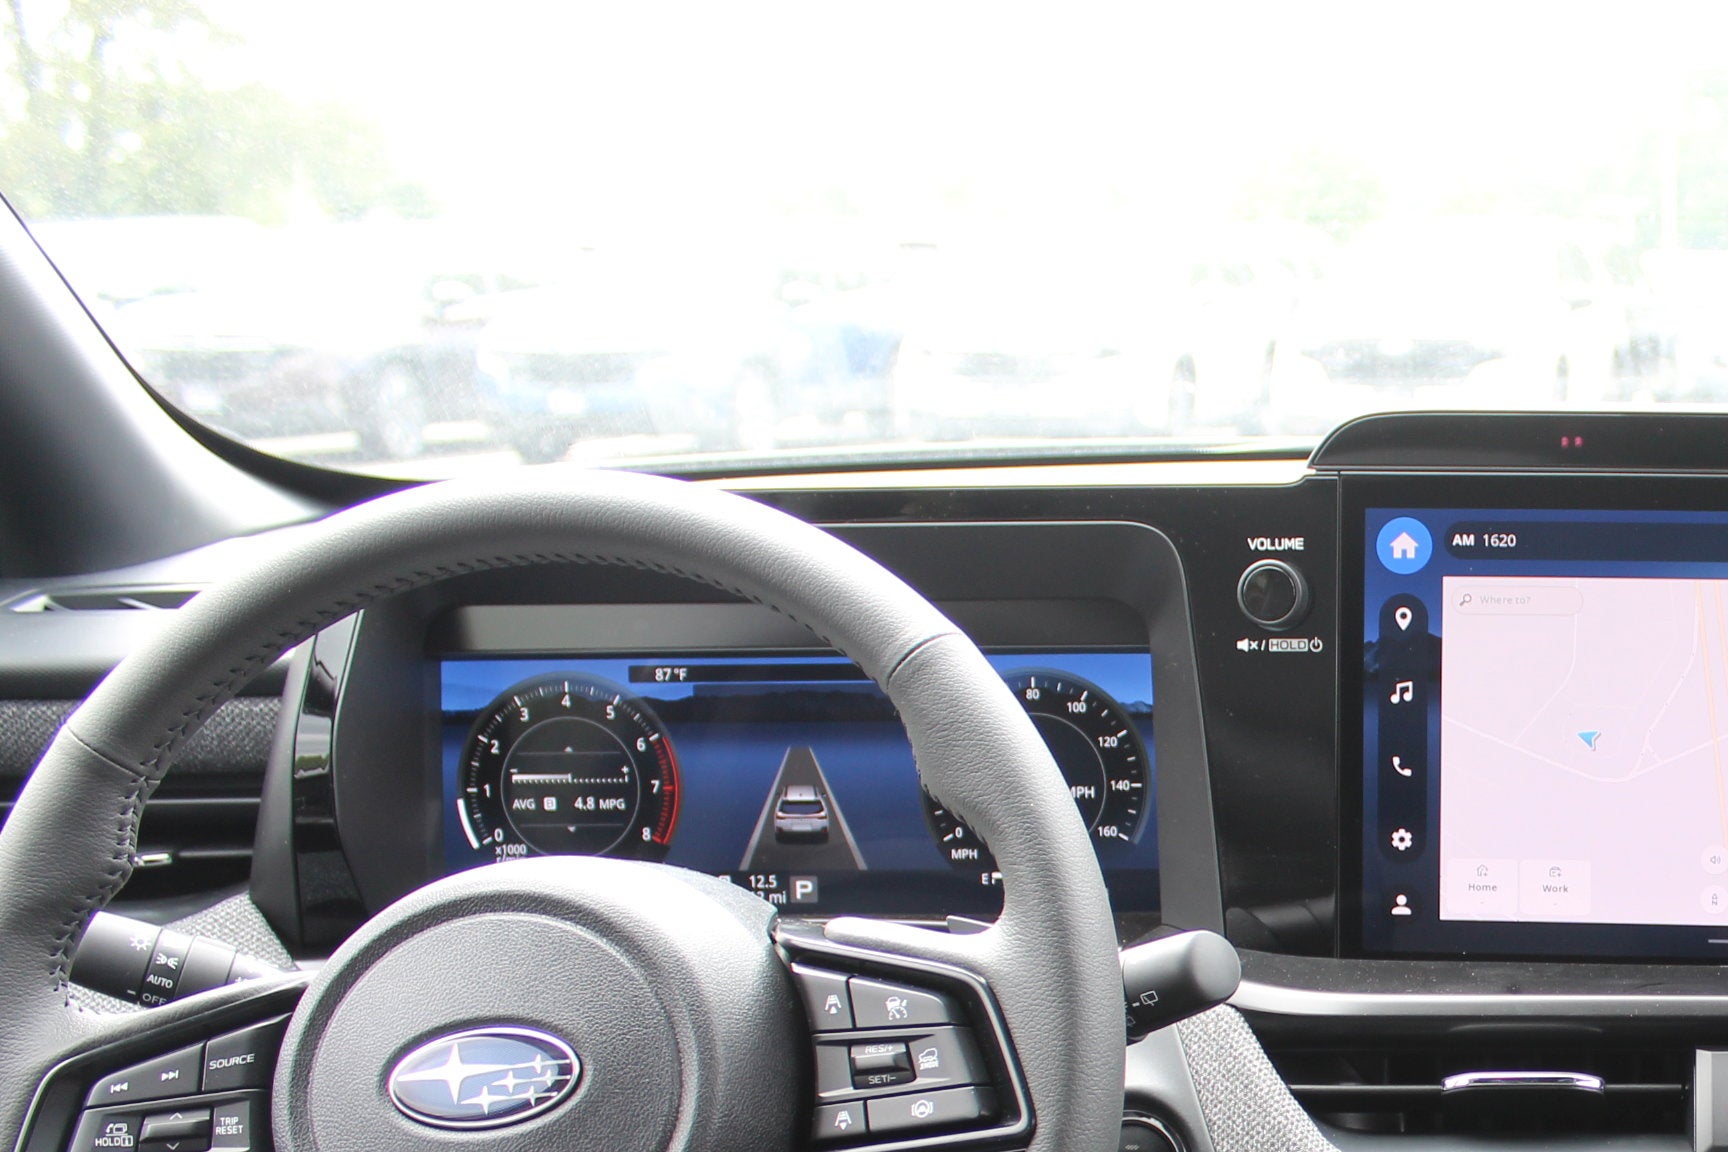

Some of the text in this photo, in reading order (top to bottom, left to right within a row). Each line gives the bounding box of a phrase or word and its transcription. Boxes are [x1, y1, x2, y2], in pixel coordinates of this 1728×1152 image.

[1248, 538, 1304, 550] VOLUME
[1452, 534, 1517, 548] AM 1620
[1480, 595, 1532, 605] Where to?
[1270, 640, 1308, 651] HOLD
[1026, 688, 1040, 700] 80
[561, 695, 571, 708] 4
[1066, 701, 1087, 714] 100
[520, 708, 530, 722] 3
[606, 705, 616, 720] 5
[490, 740, 500, 754] 2
[636, 738, 646, 752] 6
[1098, 736, 1118, 748] 120
[484, 784, 491, 798] 1
[651, 780, 660, 794] 7
[1110, 779, 1130, 792] 140
[512, 799, 536, 810] AVG
[574, 797, 595, 810] 4.8
[600, 799, 626, 810] MPG
[494, 829, 504, 842] 0
[642, 827, 651, 841] 8
[955, 827, 962, 838] 0
[1097, 826, 1118, 838] 160
[495, 844, 527, 855] x1000
[951, 849, 978, 860] MPH
[750, 875, 778, 889] 12.5
[981, 873, 990, 885] E
[796, 881, 814, 899] P
[1468, 883, 1498, 892] Home
[1542, 884, 1569, 894] Work
[770, 891, 787, 904] mi
[146, 973, 174, 990] AUTO
[142, 992, 167, 1006] OFF
[209, 1053, 256, 1070] SOURCE
[219, 1116, 239, 1127] TRIP
[215, 1124, 244, 1136] RESET
[95, 1135, 121, 1148] HOLD
